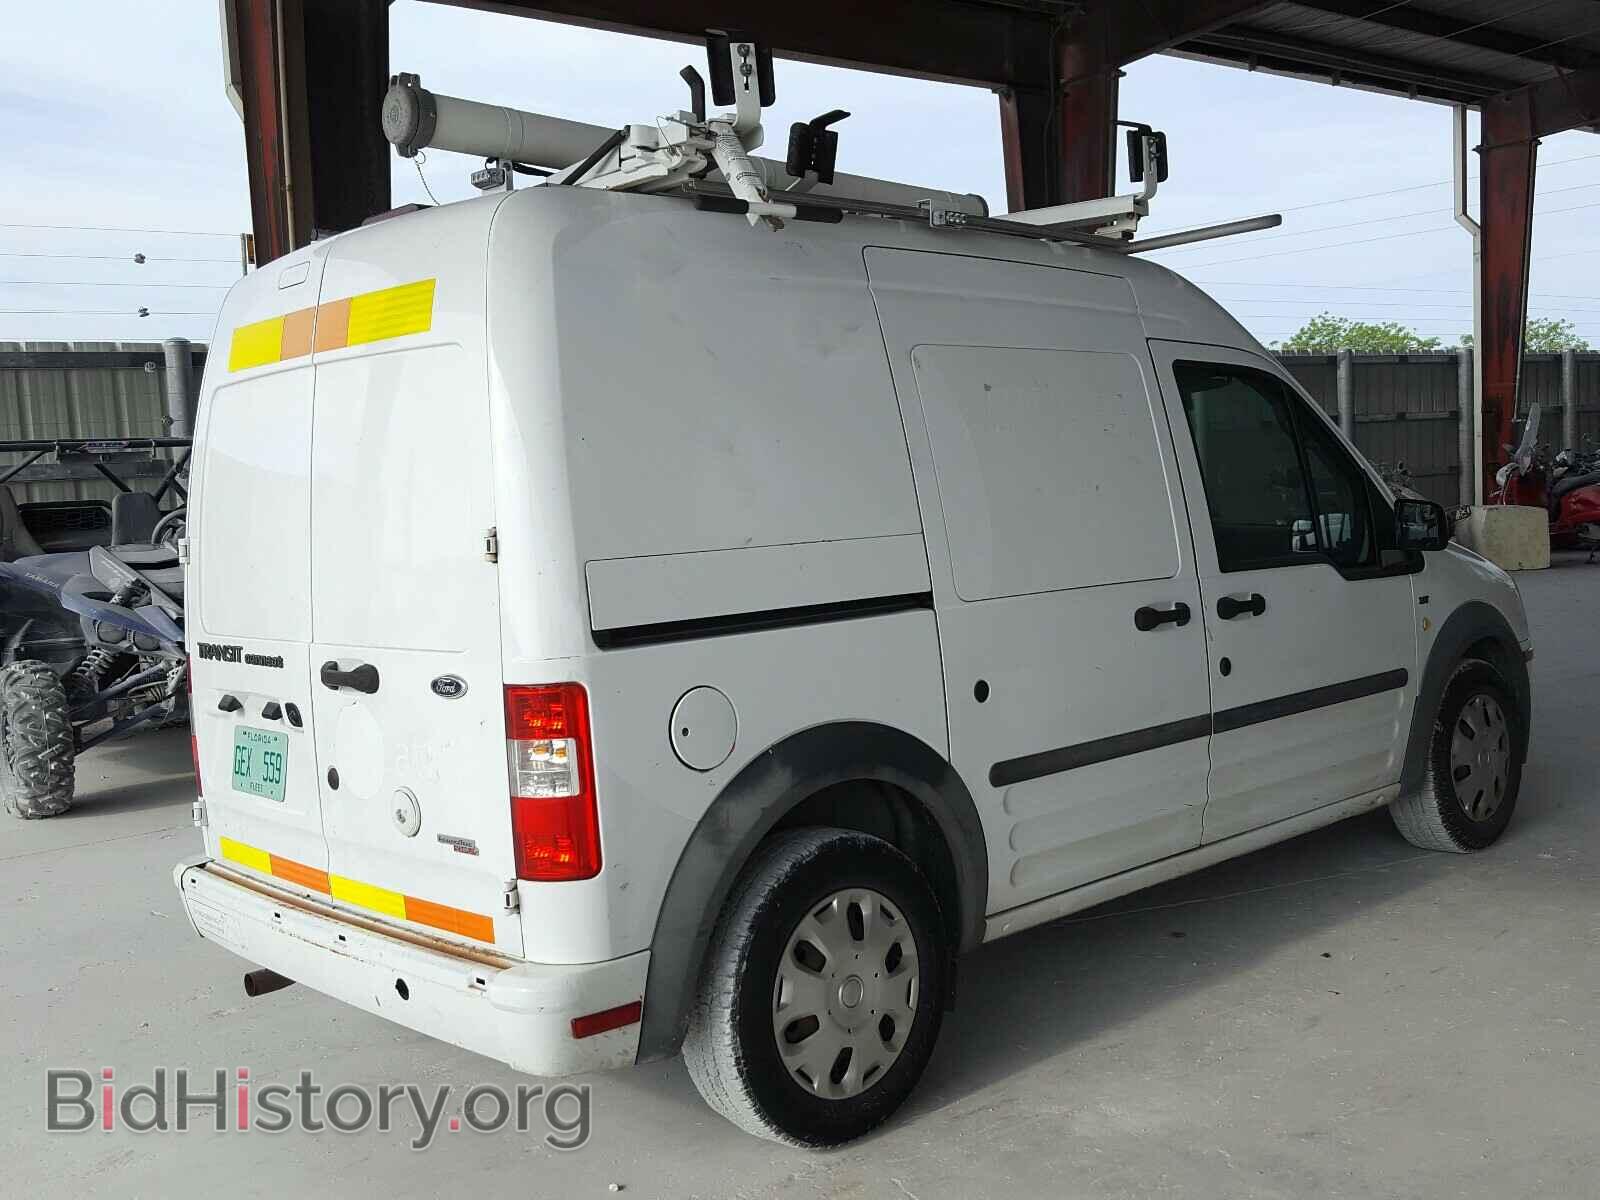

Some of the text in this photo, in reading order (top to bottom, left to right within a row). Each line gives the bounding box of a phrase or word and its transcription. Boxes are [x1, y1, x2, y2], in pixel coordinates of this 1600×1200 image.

[197, 642, 243, 663] TRANSIT
[247, 731, 271, 744] FLORIDA
[234, 745, 282, 784] GEX 559
